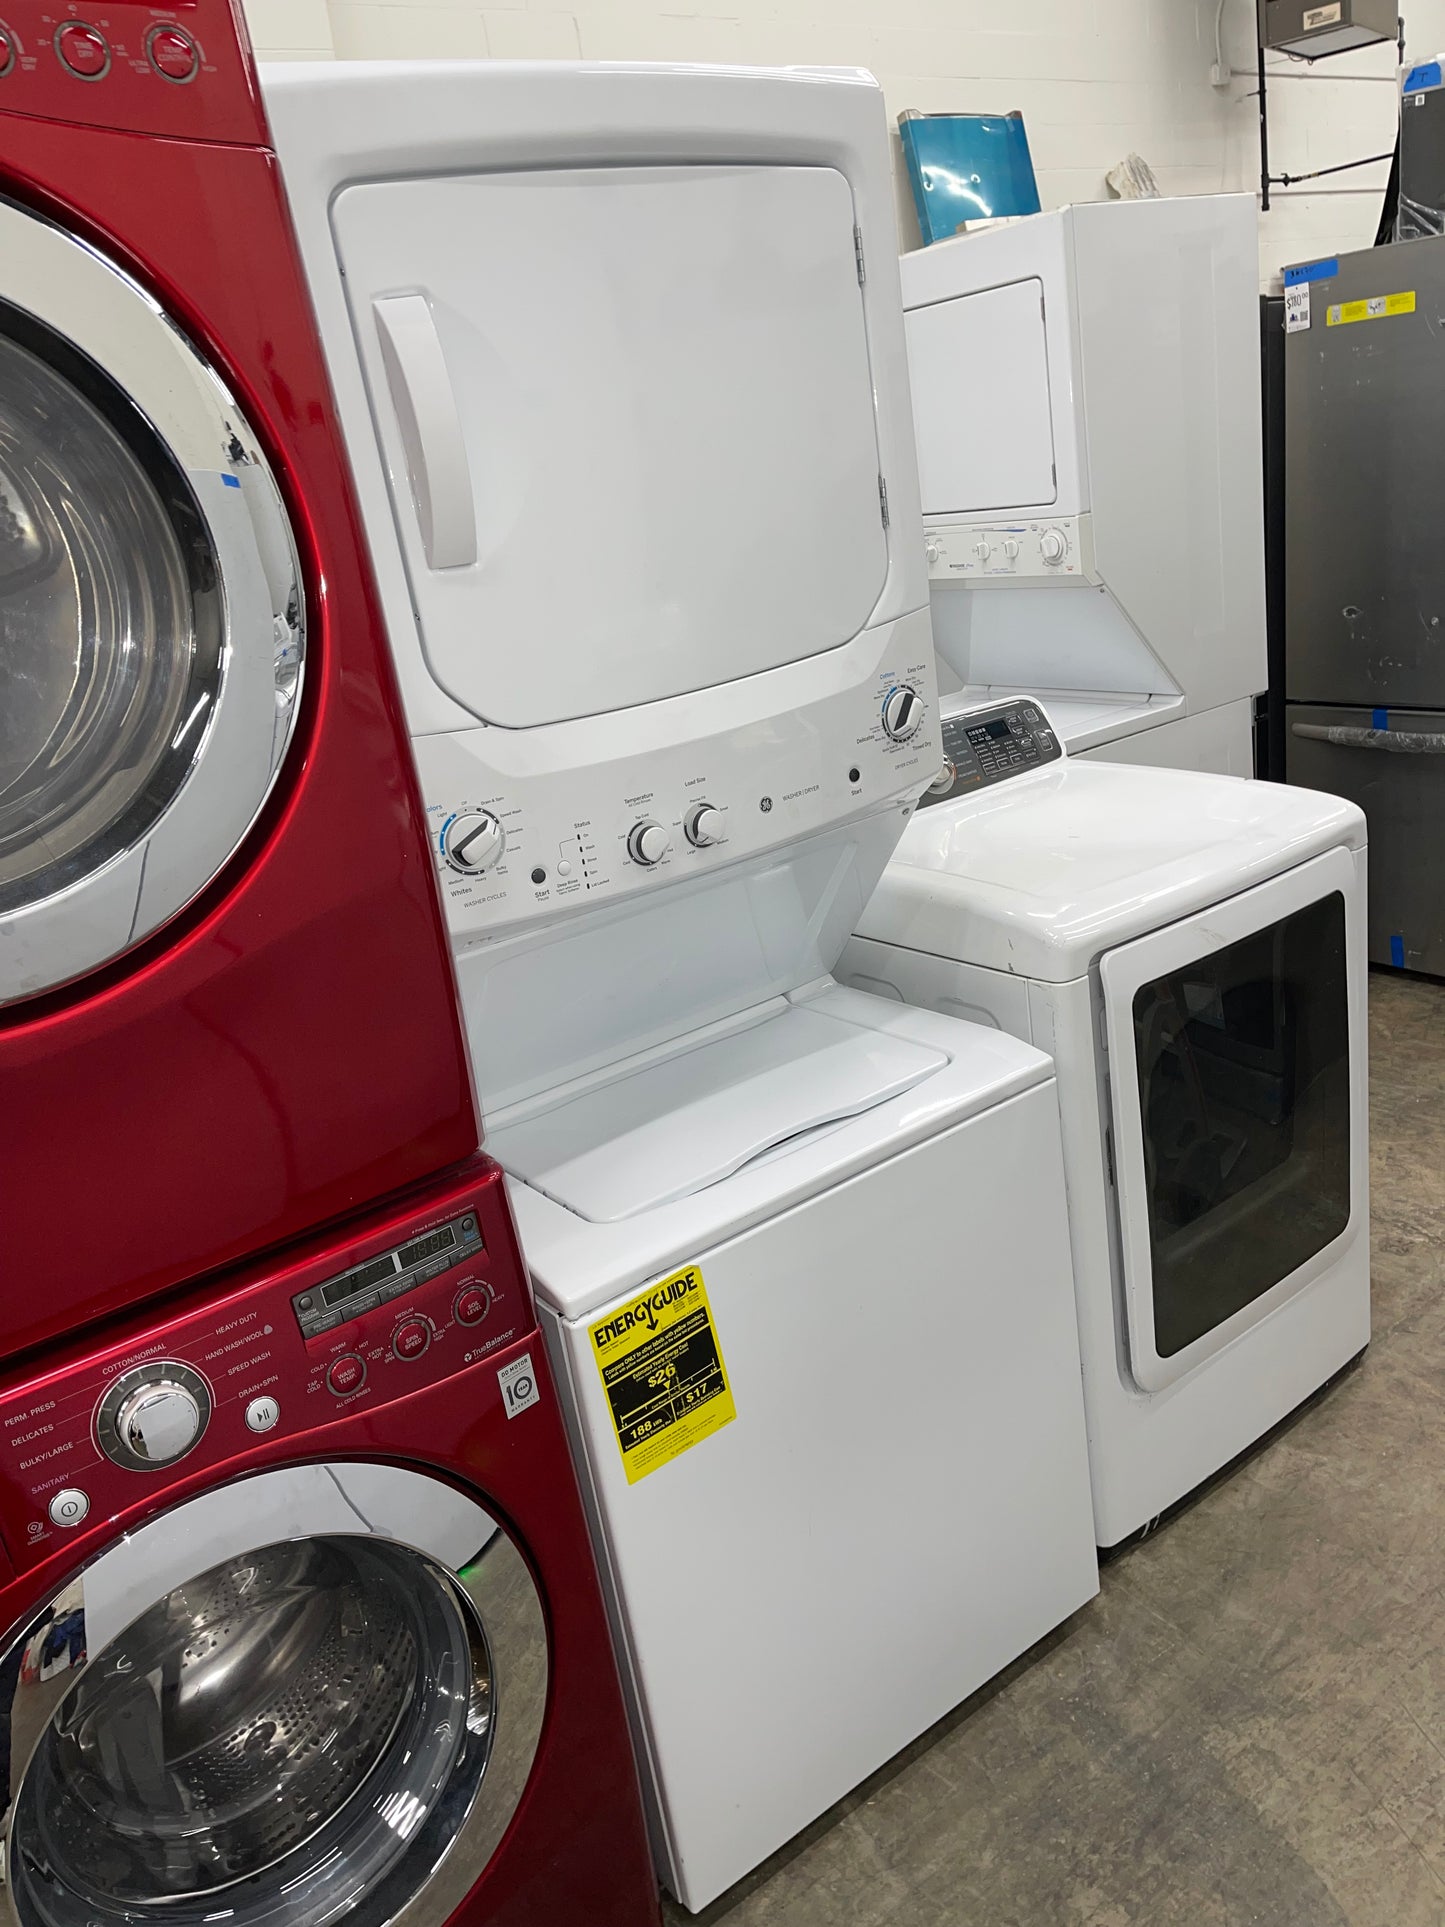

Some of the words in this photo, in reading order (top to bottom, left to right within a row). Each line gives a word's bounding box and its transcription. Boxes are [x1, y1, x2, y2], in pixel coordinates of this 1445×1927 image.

[624, 792, 654, 805] Temperature
[851, 788, 862, 796] Start
[573, 820, 591, 829] Status
[450, 887, 473, 898] Whites
[464, 896, 486, 909] WASHER
[487, 891, 507, 902] CYCLES
[534, 889, 550, 898] Start
[395, 1307, 414, 1319] MEDIUM
[467, 1305, 483, 1316] LEVEL
[594, 1272, 698, 1349] ENERGYGUIDE
[215, 1321, 238, 1335] HEAVY
[239, 1312, 258, 1327] DUTY
[205, 1346, 224, 1361] HAND
[224, 1331, 264, 1354] WASH/WOOL
[329, 1342, 347, 1353] WARM
[358, 1341, 369, 1350] HOT
[405, 1334, 419, 1344] SPIN
[405, 1338, 422, 1350] SPEED
[368, 1347, 384, 1358] EXTRA
[605, 1362, 624, 1377] Compare
[624, 1354, 637, 1364] ONLY
[641, 1344, 652, 1354] other
[652, 1336, 665, 1348] labels
[665, 1331, 674, 1340] with
[674, 1323, 687, 1336] yellow
[102, 1343, 167, 1376] COTTON/NORMAL
[228, 1360, 249, 1376] SPEED
[249, 1351, 271, 1368] WASH
[501, 1370, 509, 1378] DD
[510, 1358, 528, 1373] MOTOR
[310, 1363, 325, 1374] COLD
[337, 1367, 355, 1379] WASH
[647, 1363, 676, 1388] $26
[238, 1374, 279, 1399] DRAIN+SPIN
[307, 1380, 318, 1388] TAP
[307, 1384, 321, 1394] COLD
[506, 1376, 532, 1406] 10
[518, 1383, 528, 1392] YEAR
[686, 1382, 707, 1403] $17
[336, 1401, 344, 1409] ALL
[344, 1393, 356, 1405] COLD
[355, 1387, 371, 1399] RINSES
[511, 1395, 535, 1412] WARRANTY
[4, 1410, 30, 1427] PERM.
[31, 1401, 56, 1416] PRESS
[11, 1424, 54, 1447] DELICATES
[630, 1420, 653, 1439] 188
[20, 1442, 74, 1470] BULKY/LARGE
[31, 1473, 70, 1494] SANITARY
